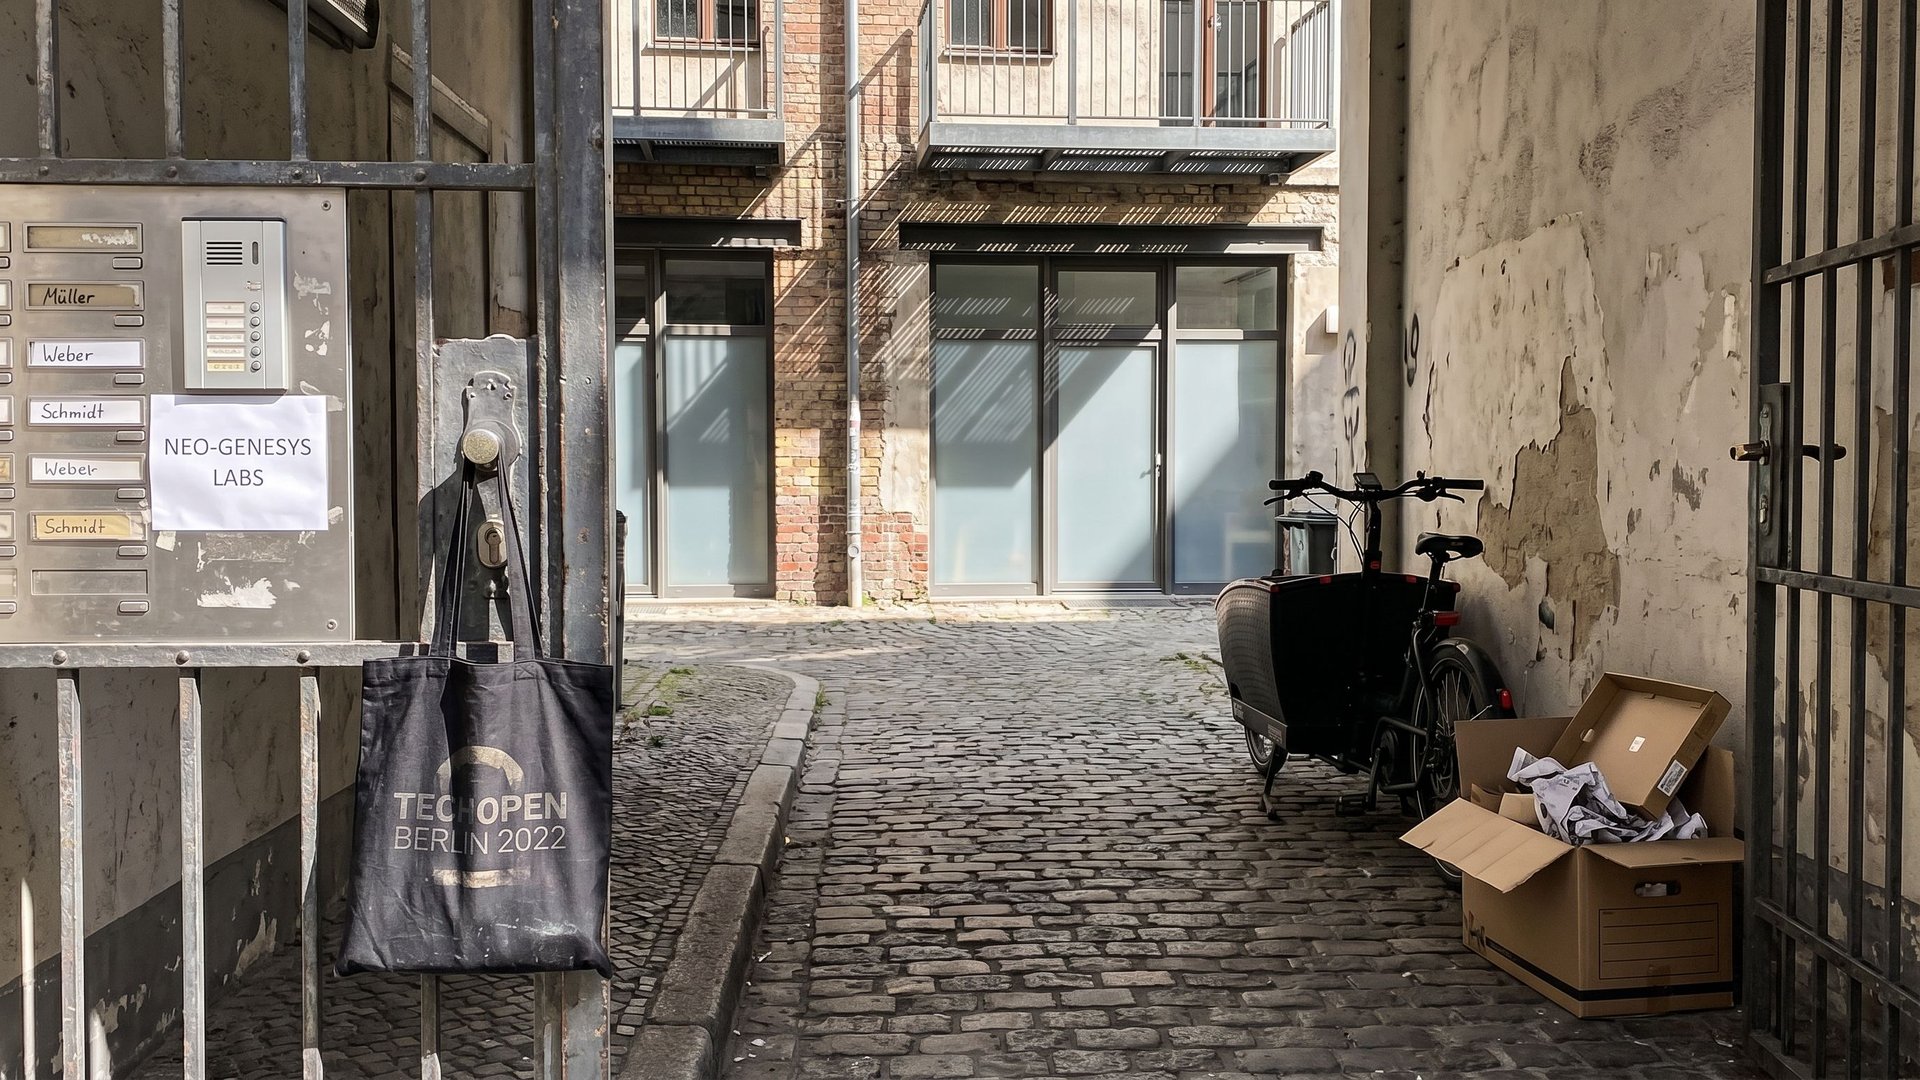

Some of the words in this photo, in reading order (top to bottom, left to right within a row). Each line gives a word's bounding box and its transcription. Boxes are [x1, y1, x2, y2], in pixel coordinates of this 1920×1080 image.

[43, 287, 95, 305] Müller
[43, 344, 93, 362] Weber
[41, 402, 104, 419] Schmidt
[164, 438, 311, 456] NEO-GENESYS
[44, 462, 98, 476] Weber
[213, 468, 264, 487] LABS
[44, 518, 105, 534] Schmidt
[393, 826, 489, 856] BERLIN
[497, 825, 567, 854] 2022
